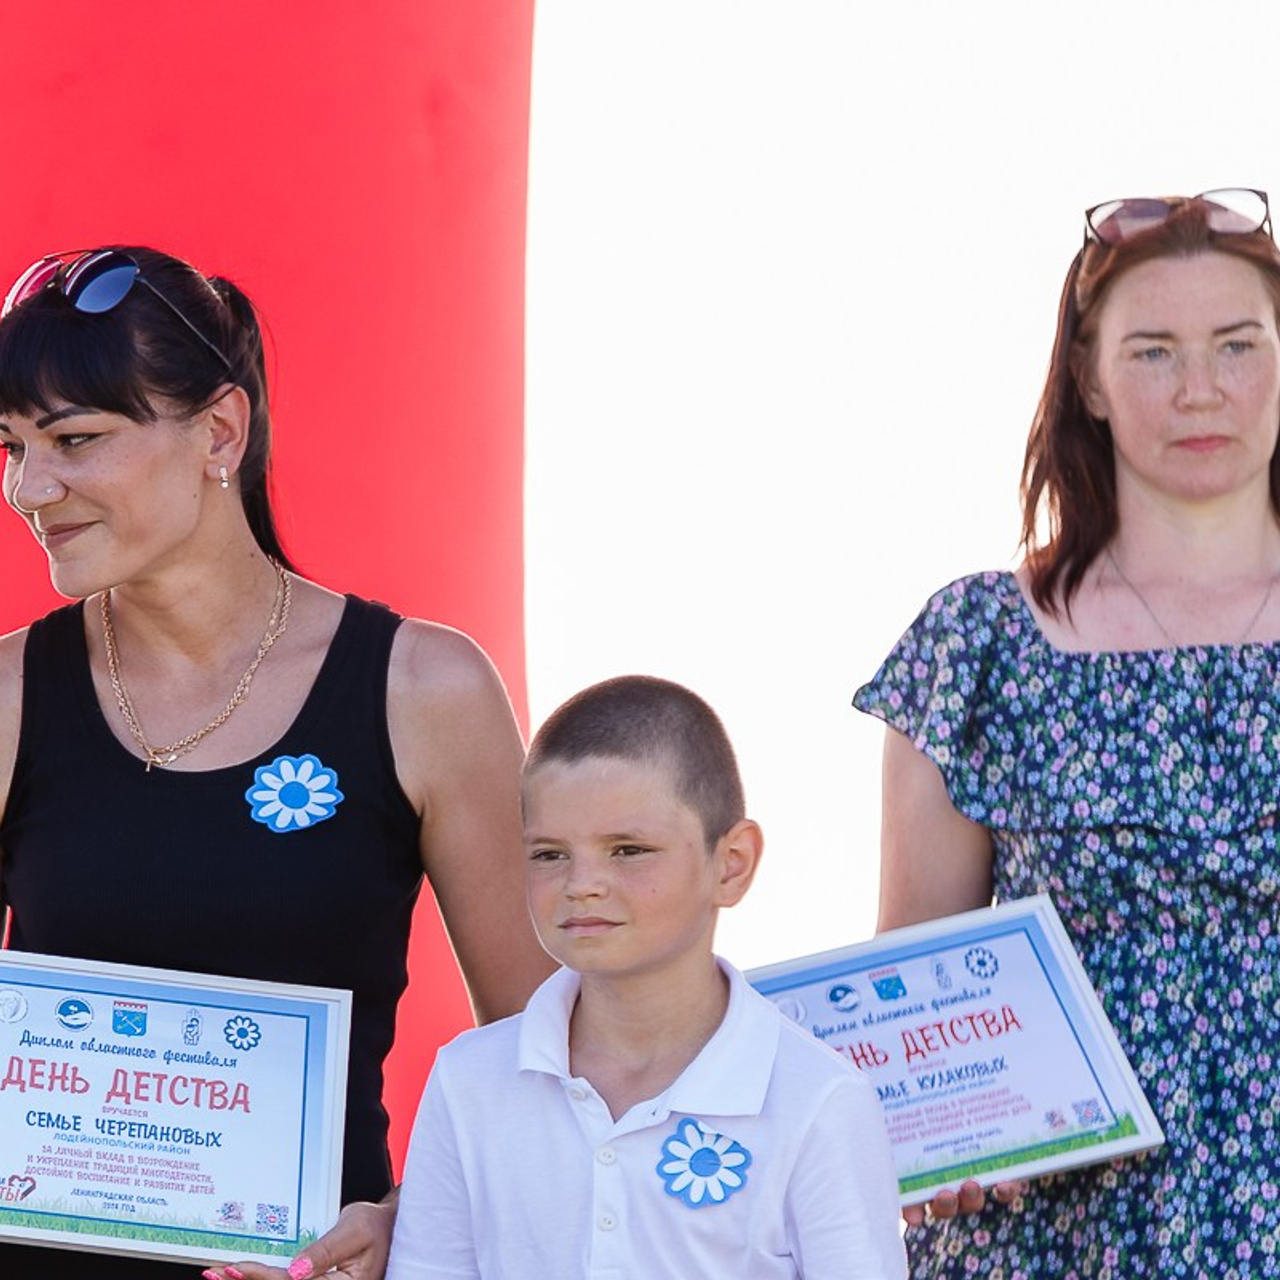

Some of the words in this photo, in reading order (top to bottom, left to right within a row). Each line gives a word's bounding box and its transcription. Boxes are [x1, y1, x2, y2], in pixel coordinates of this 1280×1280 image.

[901, 1004, 1023, 1063] ДЕТСТВА
[19, 1029, 74, 1049] Диплом
[80, 1037, 156, 1059] областного
[163, 1049, 238, 1068] фестиваля
[0, 1055, 91, 1094] ДЕНЬ
[105, 1068, 251, 1113] ДЕТСТВА
[25, 1110, 82, 1132] СЕМЬЕ
[95, 1118, 223, 1148] ЧЕРЕПАНОВЫХ
[53, 1132, 155, 1151] ЛОДЕЙНОПОЛЬСКИЙ
[157, 1144, 191, 1155] РАЙОН
[36, 1155, 90, 1170] УКРЕПЛЕНИЕ
[93, 1161, 139, 1175] ТРАДИЦИЙ
[54, 1147, 93, 1158] ЛИЧНЫЙ
[95, 1151, 125, 1164] ВКЛАД
[128, 1155, 134, 1164] В
[137, 1156, 200, 1171] ВОЗРОЖДЕНИЕ
[76, 1171, 130, 1187] ВОСПИТАНИЕ
[143, 1179, 186, 1192] РАЗВИТИЕ
[188, 1183, 216, 1195] ДЕТЕЙ
[121, 1203, 136, 1213] ГОД
